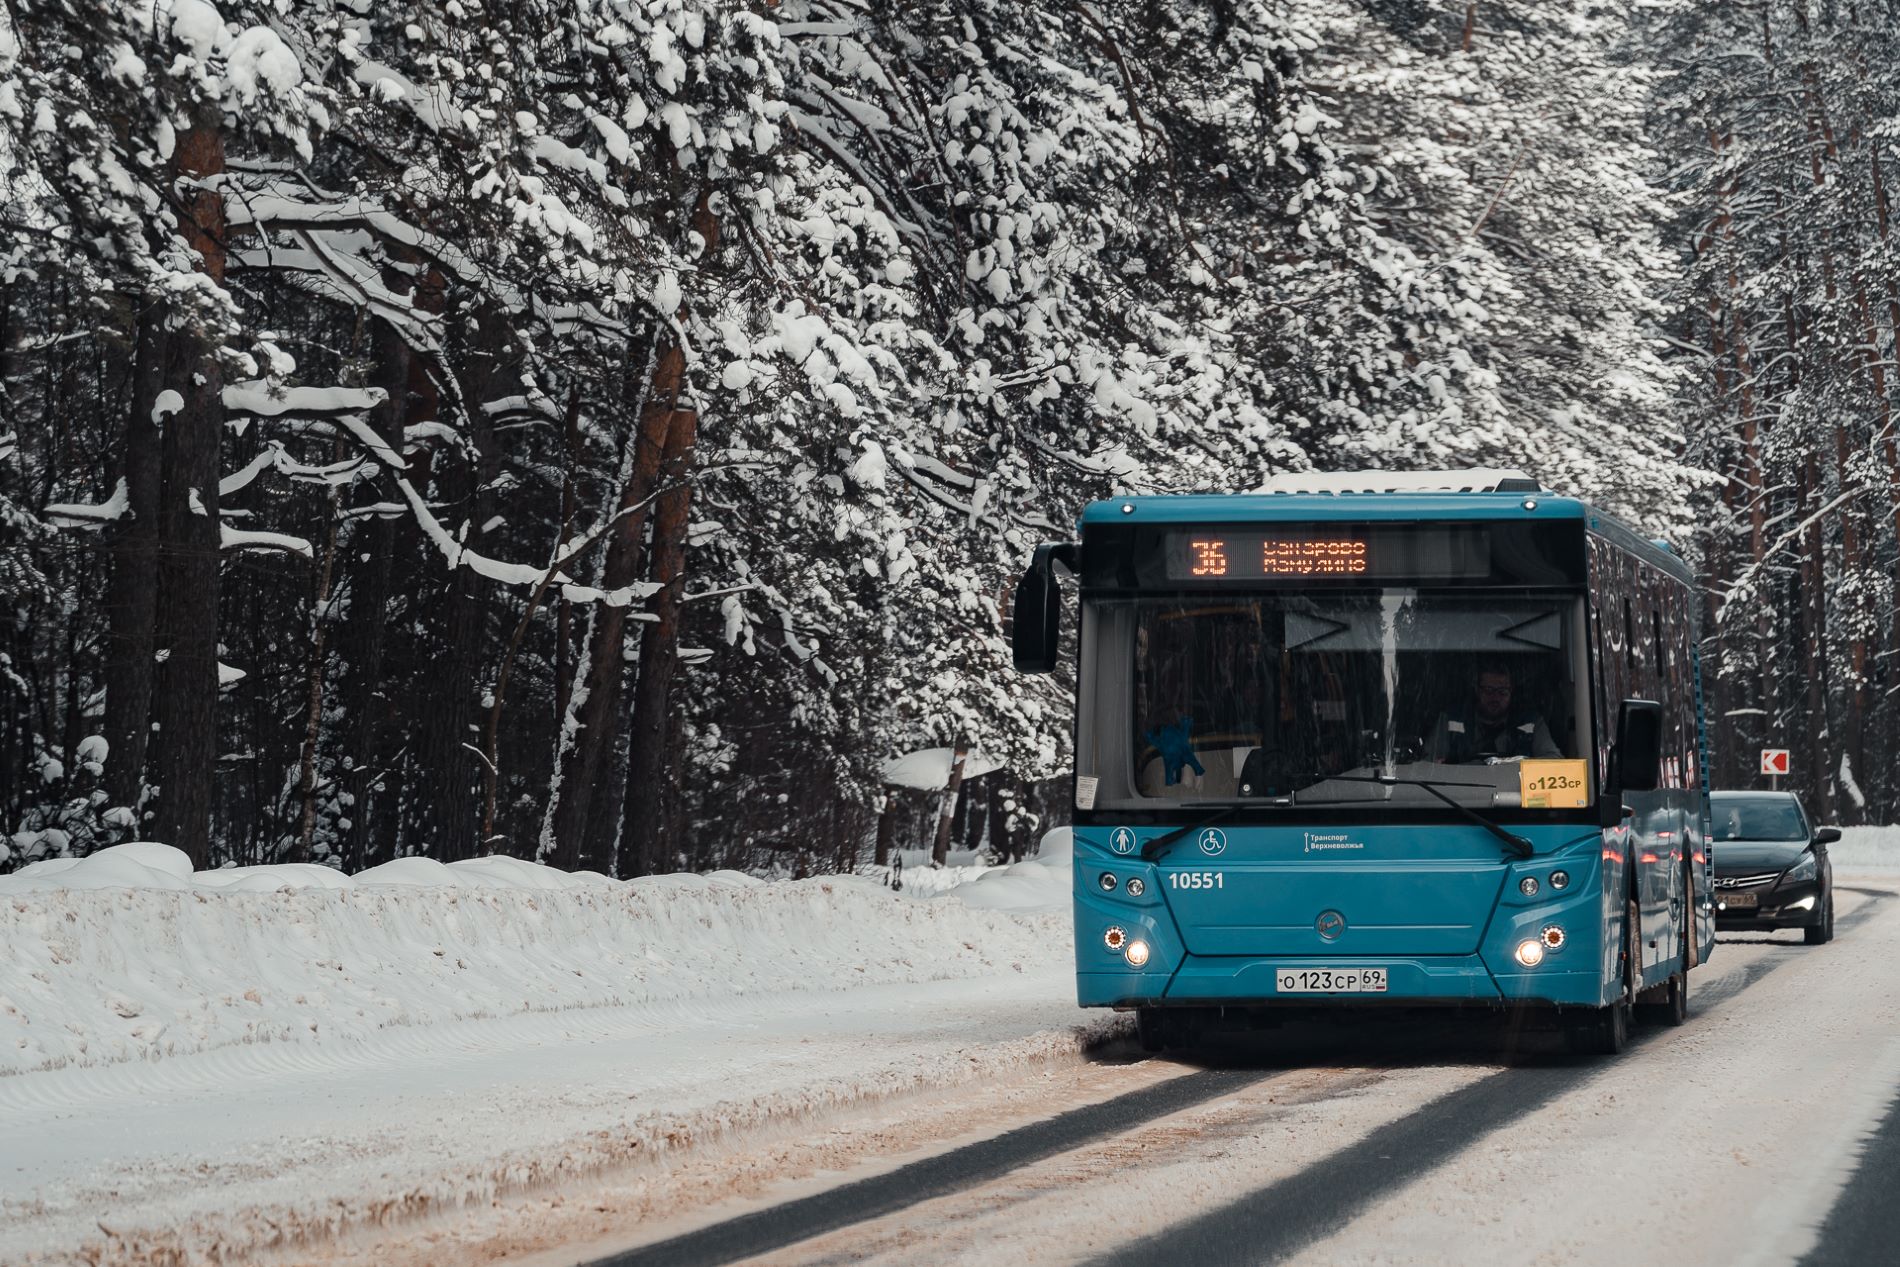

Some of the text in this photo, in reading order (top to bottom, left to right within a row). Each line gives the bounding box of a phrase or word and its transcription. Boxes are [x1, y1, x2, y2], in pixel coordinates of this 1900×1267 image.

[1192, 542, 1226, 575] 36
[1310, 834, 1348, 842] Транспорт
[1168, 872, 1223, 889] 10551
[1362, 970, 1381, 984] 69
